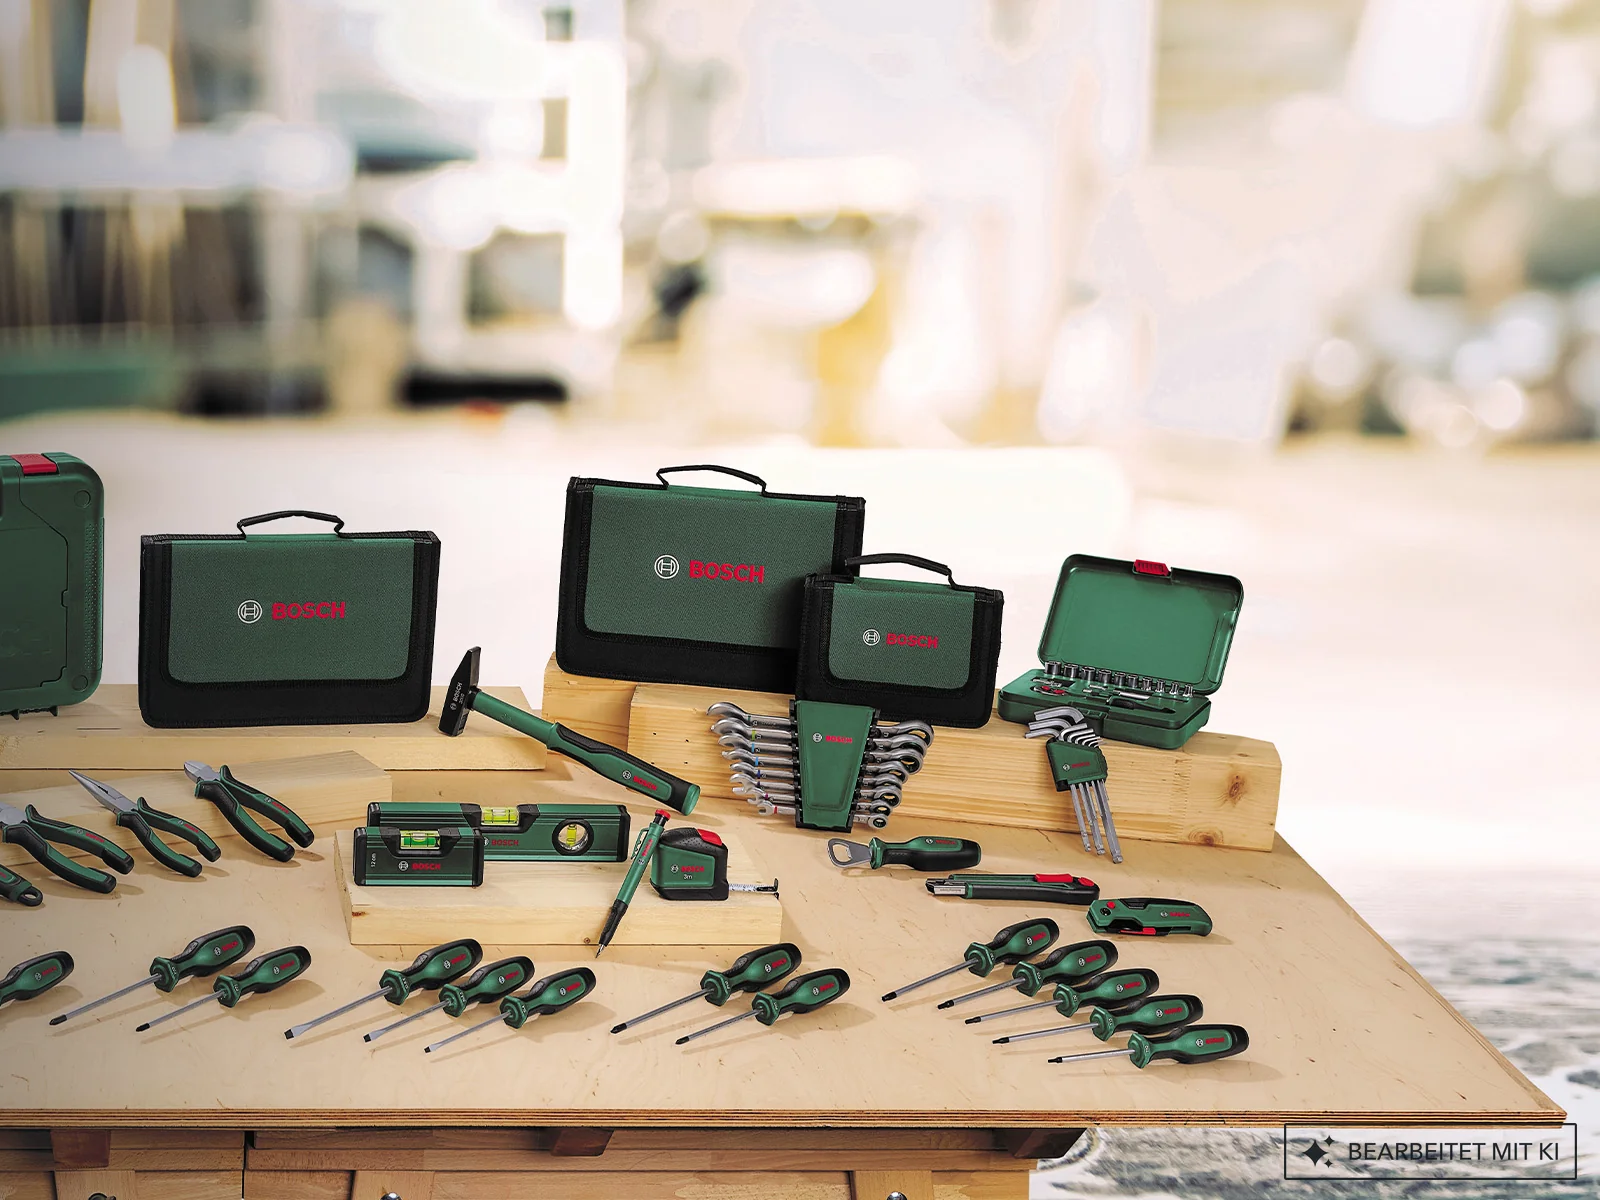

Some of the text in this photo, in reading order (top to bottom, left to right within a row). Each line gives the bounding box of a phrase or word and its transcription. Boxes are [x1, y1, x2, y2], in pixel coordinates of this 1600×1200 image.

[688, 560, 766, 585] BOSCH
[271, 601, 346, 620] BOSCH
[885, 632, 940, 650] BOSCH
[411, 862, 441, 871] BOSCH
